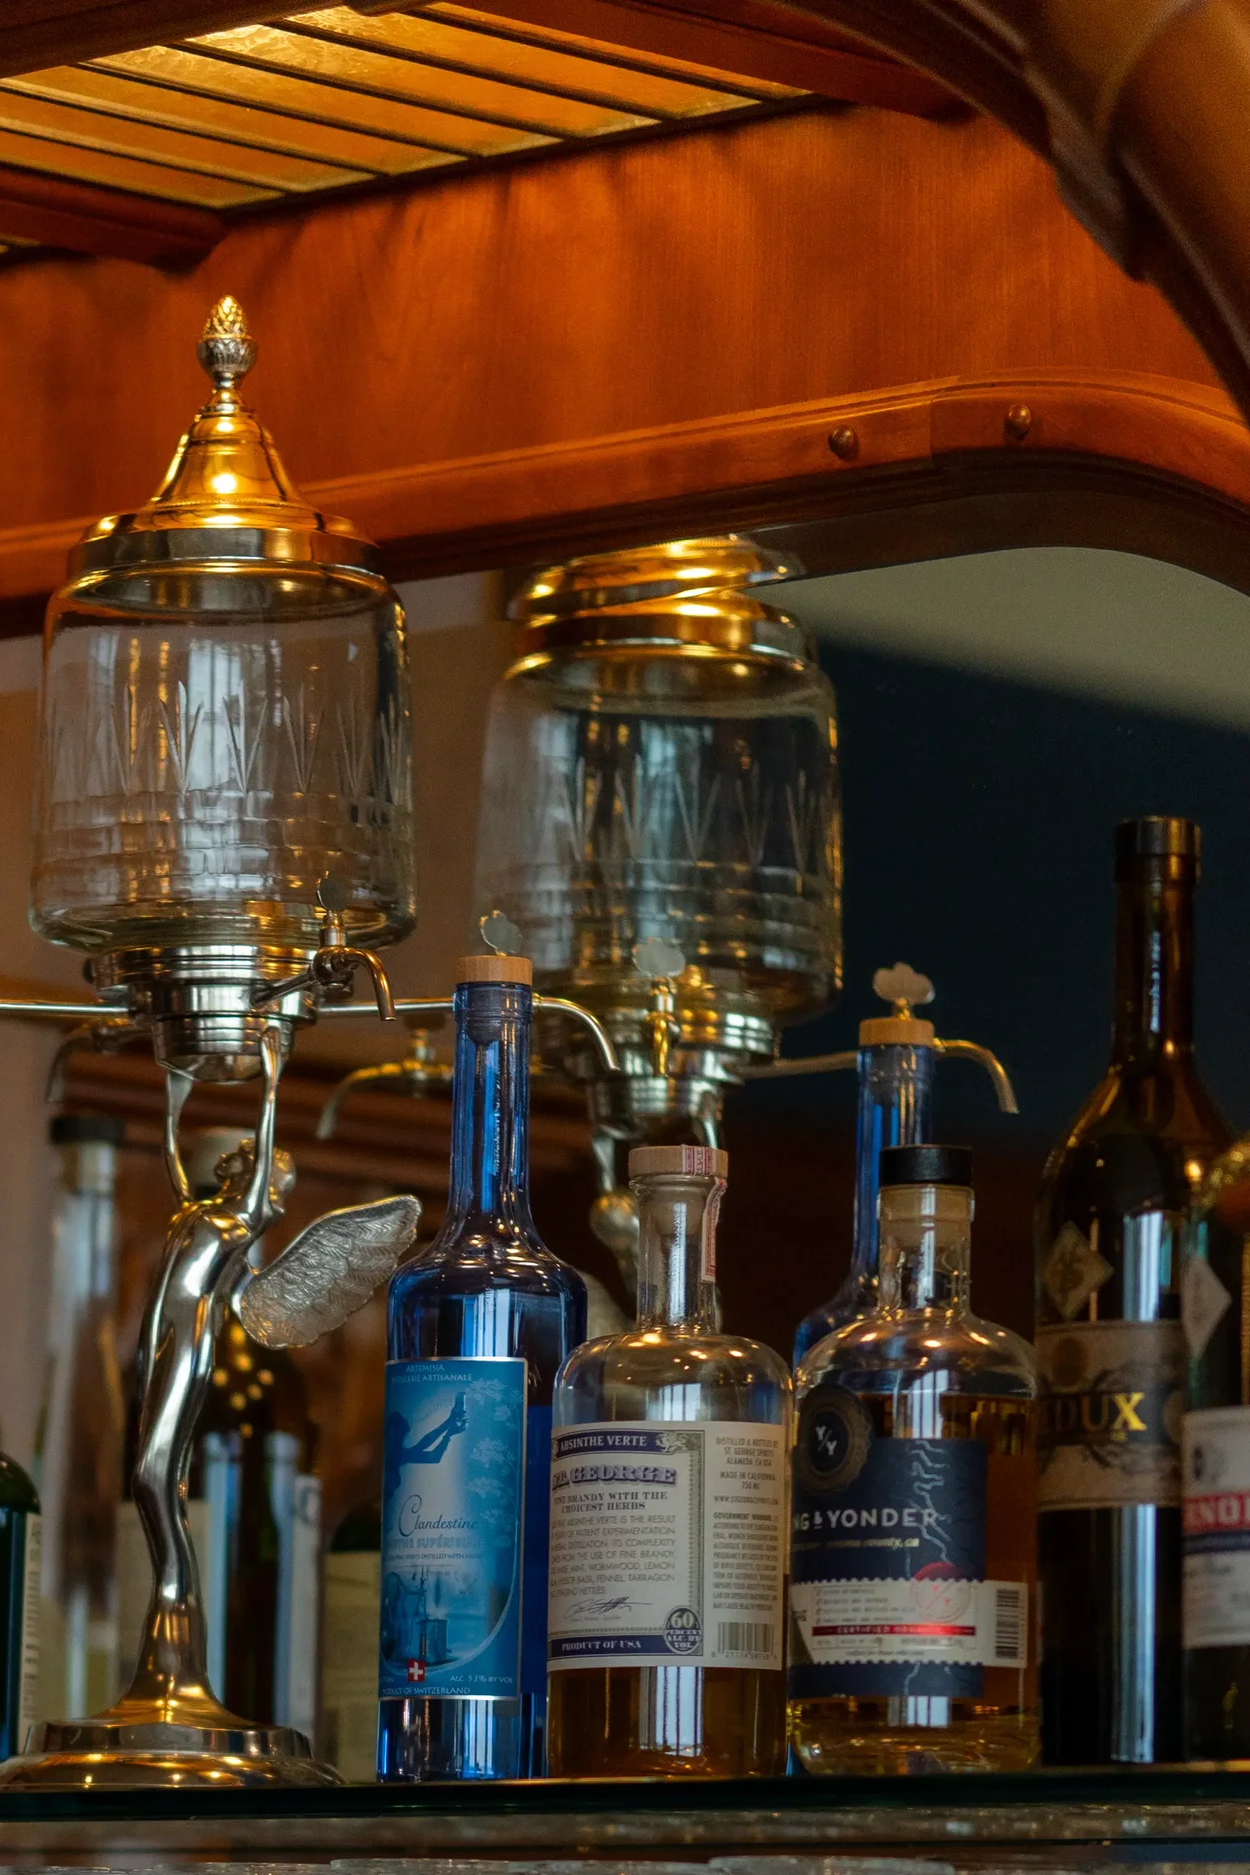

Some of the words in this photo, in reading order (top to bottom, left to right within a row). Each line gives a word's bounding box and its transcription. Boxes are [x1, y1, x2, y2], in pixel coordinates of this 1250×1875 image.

[406, 1364, 446, 1373] ARTEMISIA
[422, 1374, 473, 1382] ARTISANALE
[560, 1436, 604, 1449] ABSINTHE
[607, 1436, 647, 1446] VERTE
[570, 1465, 676, 1485] GEORGE
[568, 1493, 604, 1503] BRANDY
[643, 1491, 667, 1500] THE
[561, 1504, 604, 1514] CHOICEST
[607, 1502, 645, 1510] HERBS
[399, 1494, 478, 1537] Clandestine
[597, 1516, 617, 1524] VERTE
[620, 1515, 627, 1523] IS
[630, 1515, 644, 1523] THE
[648, 1515, 676, 1523] RESULT
[827, 1509, 938, 1528] YONDER
[602, 1526, 675, 1536] EXPERIMENTATION
[625, 1538, 676, 1546] COMPLEXITY
[591, 1551, 603, 1560] USE
[605, 1551, 617, 1559] OF
[619, 1550, 637, 1558] FINE
[640, 1550, 676, 1559] BRANDY,
[589, 1562, 642, 1571] WORMWOOD,
[644, 1562, 675, 1570] LEMON
[597, 1574, 625, 1583] FENNEL,
[628, 1574, 675, 1582] TARRAGON
[671, 1611, 695, 1629] 60
[562, 1640, 600, 1650] PRODUCT
[603, 1640, 616, 1648] OF
[620, 1640, 641, 1648] USA
[488, 1675, 497, 1683] BY
[499, 1676, 513, 1684] VOL
[414, 1686, 470, 1695] SWITZERLAND
